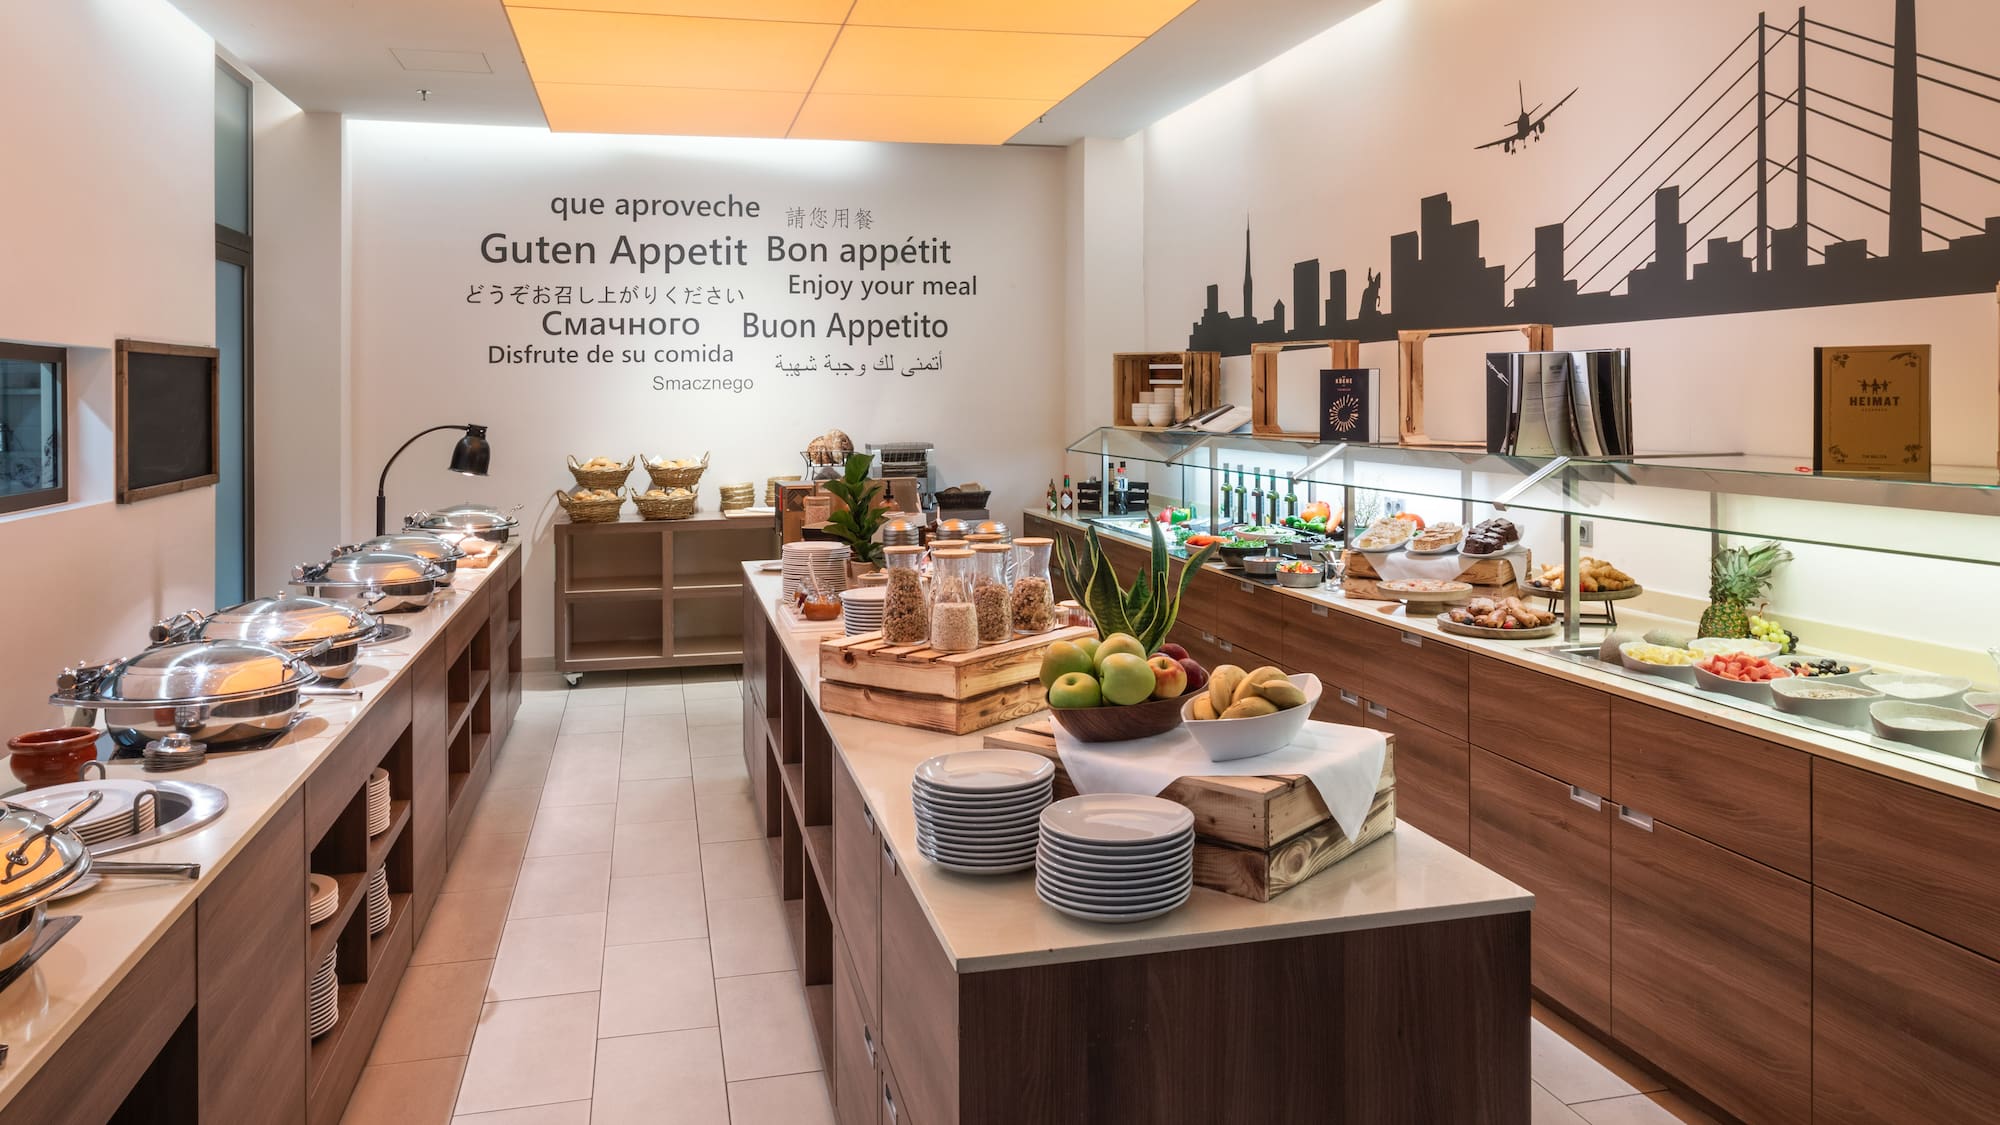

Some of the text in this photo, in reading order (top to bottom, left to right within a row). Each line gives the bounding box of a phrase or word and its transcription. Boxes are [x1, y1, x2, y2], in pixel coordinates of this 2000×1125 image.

[551, 193, 761, 223] que aproveche
[785, 206, 875, 230] 請您用餐
[480, 232, 748, 274] Guten Appetit
[767, 235, 952, 272] Bon appétit
[466, 284, 745, 306] どうぞお召し上がりください
[788, 273, 978, 302] Enjoy your meal
[541, 310, 700, 336] Смачного
[743, 311, 949, 347] Buon Appetito
[488, 343, 734, 364] Disfrute de su comida
[775, 353, 818, 377] شهية
[872, 353, 895, 371] لك
[652, 375, 754, 394] Smacznego
[1849, 395, 1900, 407] HEIMAT
